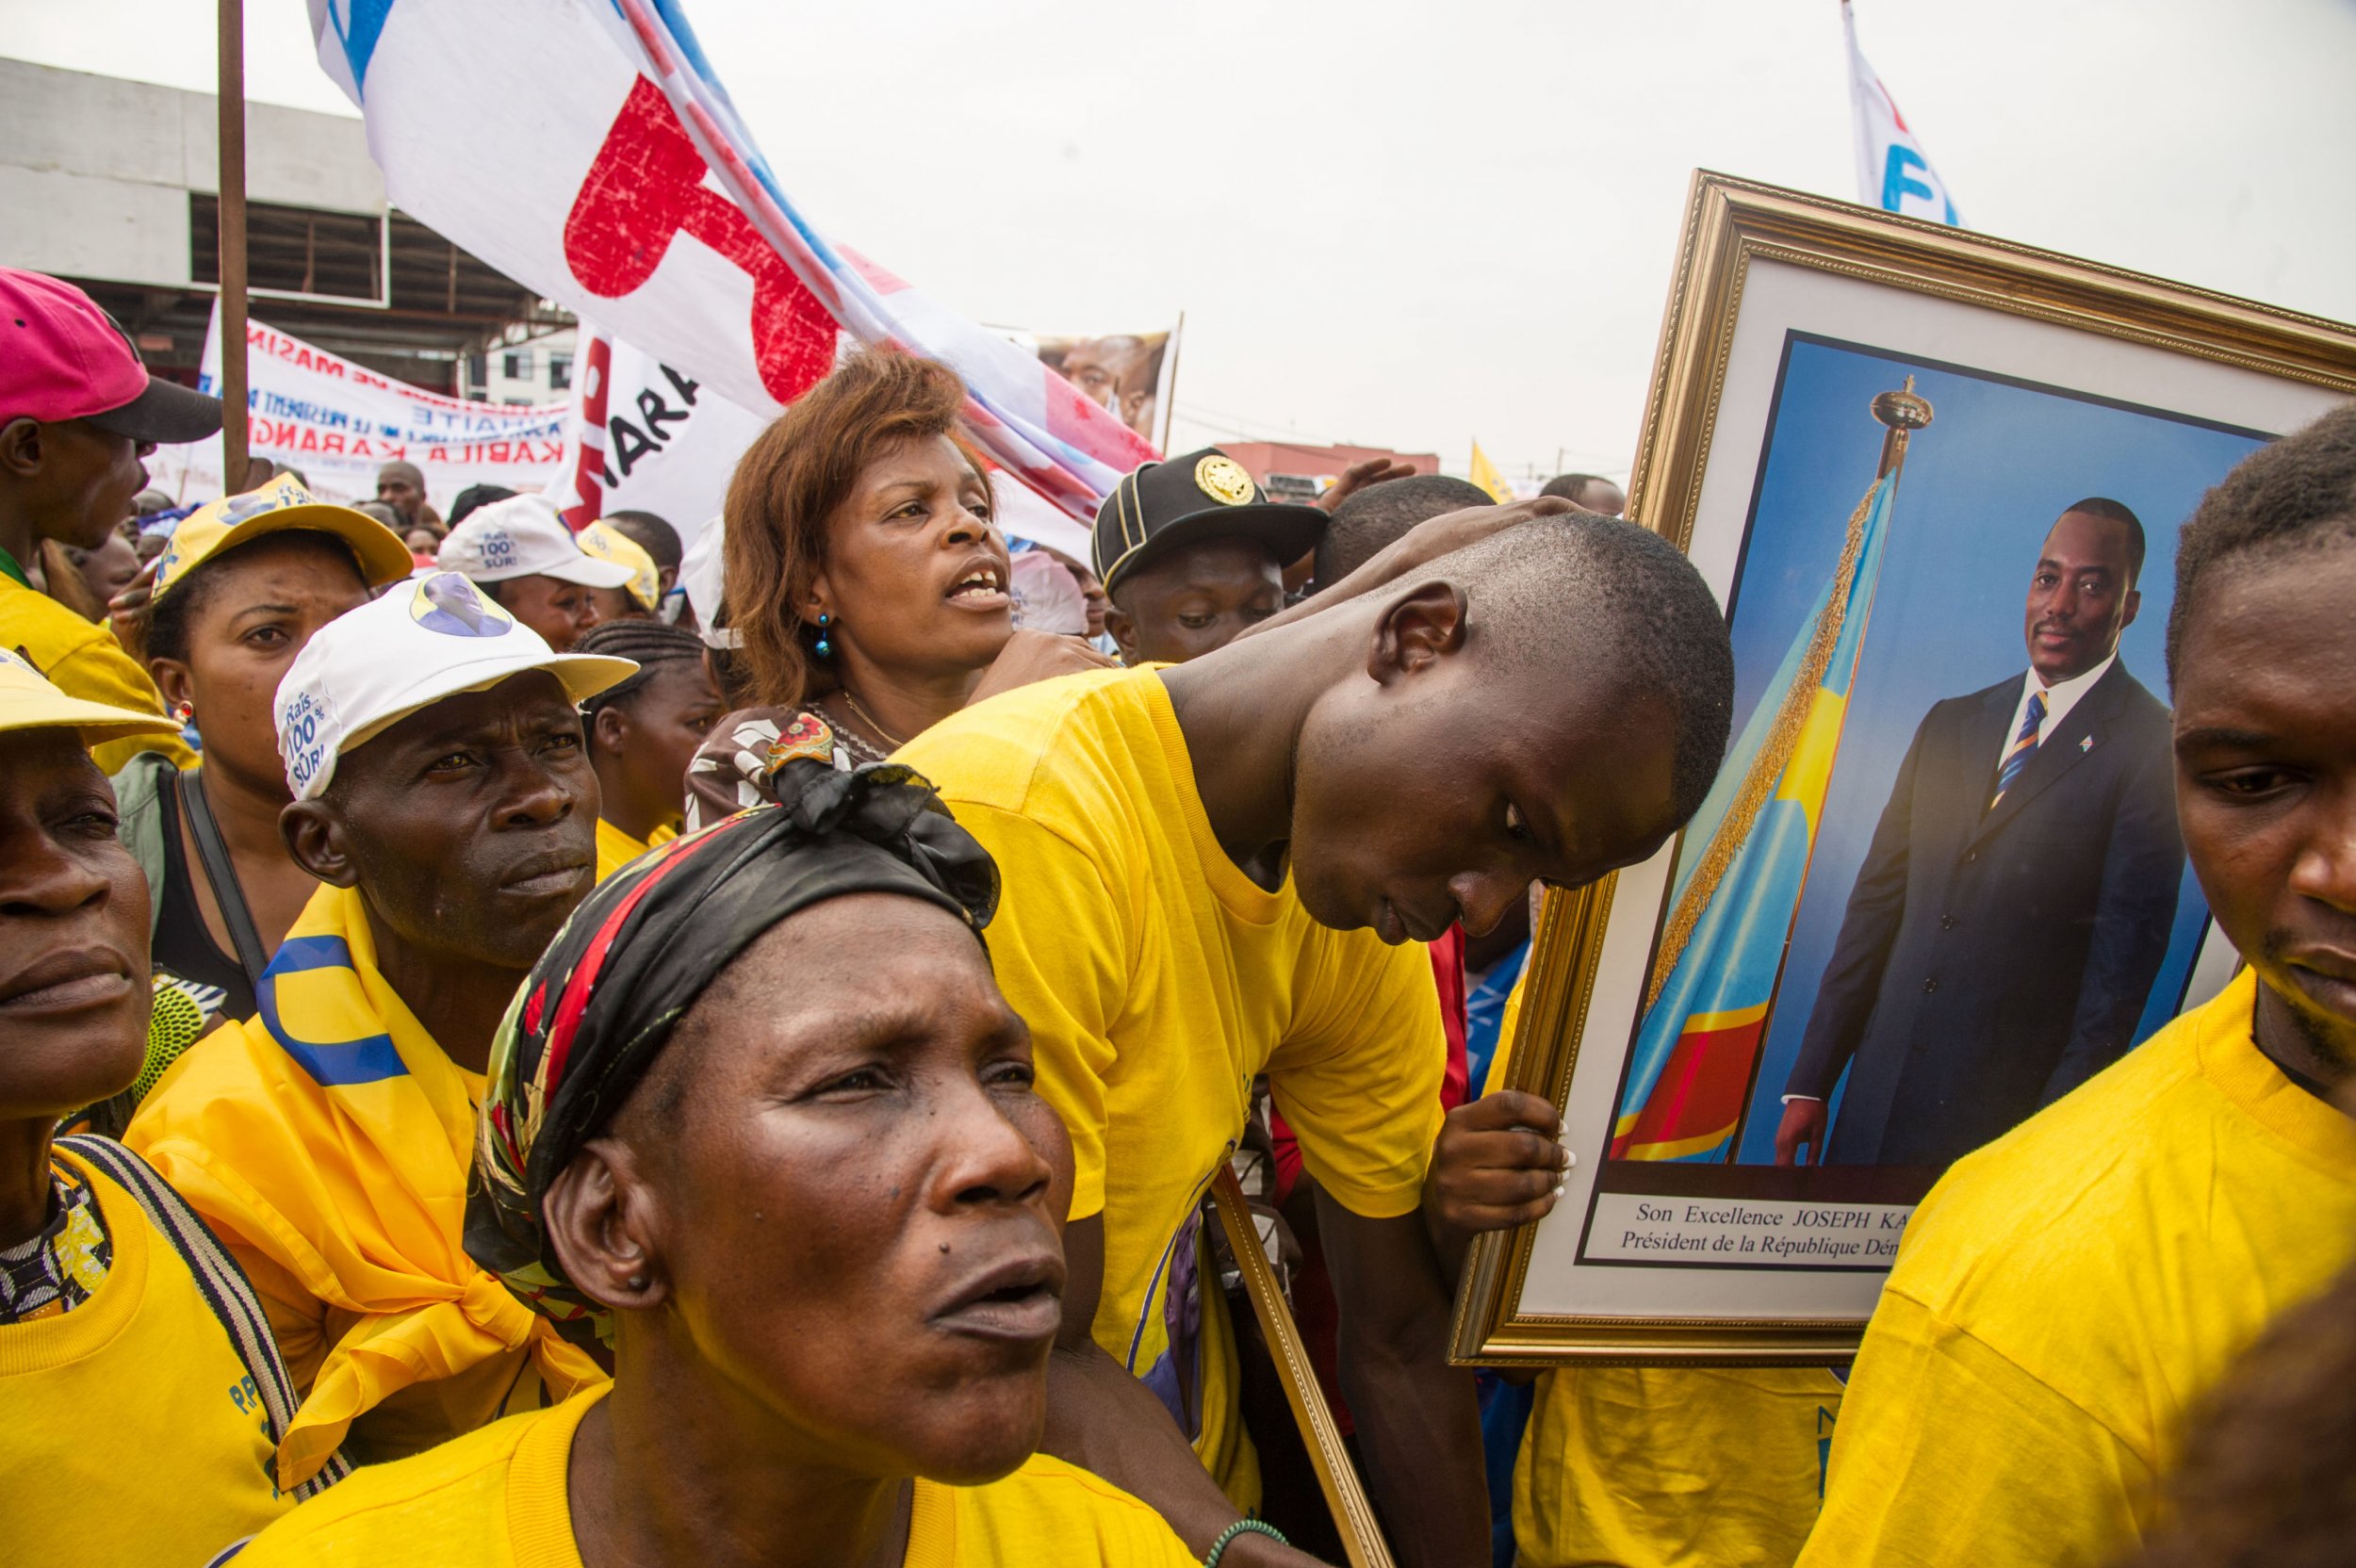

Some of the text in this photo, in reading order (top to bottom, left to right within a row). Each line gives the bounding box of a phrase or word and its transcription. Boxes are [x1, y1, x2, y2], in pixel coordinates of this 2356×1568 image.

[1636, 1203, 1908, 1230] Son Excellence JOSEPH KA
[1621, 1231, 1708, 1251] Président
[1712, 1234, 1734, 1252] de
[1739, 1235, 1756, 1252] la
[1760, 1236, 1860, 1259] République
[228, 1375, 258, 1415] PP
